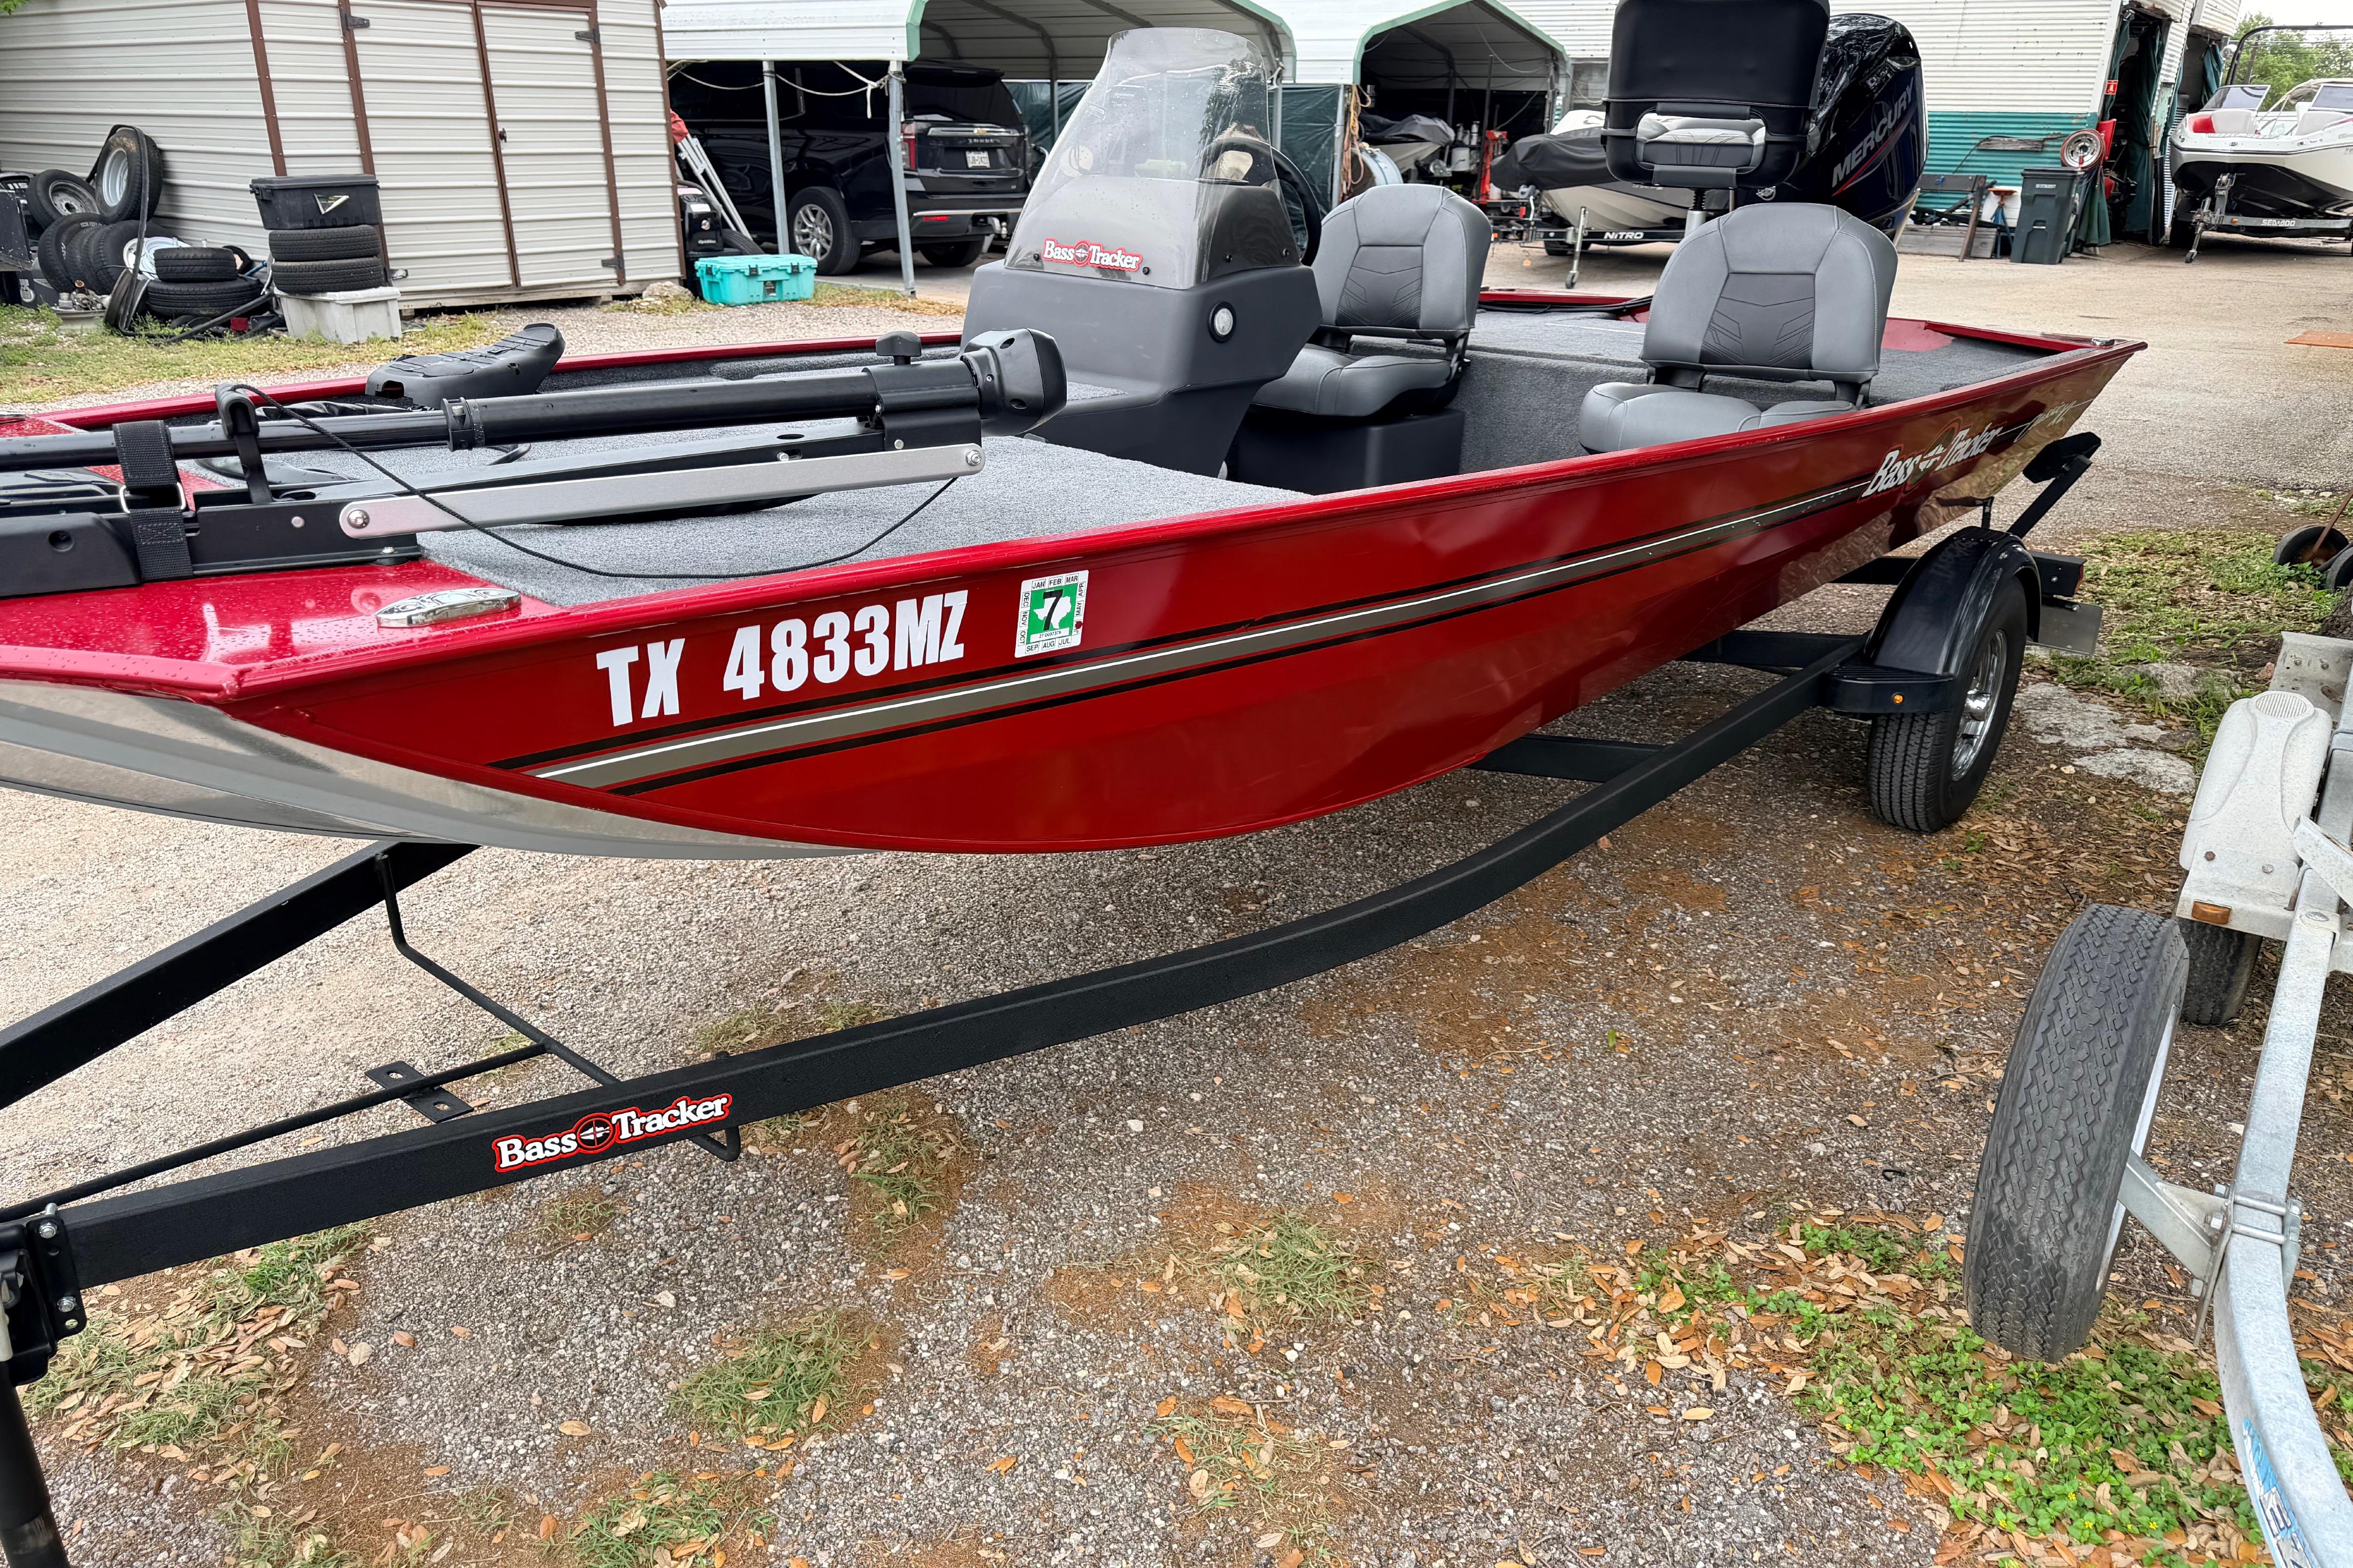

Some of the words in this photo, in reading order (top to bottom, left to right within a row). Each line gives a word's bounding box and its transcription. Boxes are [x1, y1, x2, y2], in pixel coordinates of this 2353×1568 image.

[1832, 76, 1914, 188] MERCURY
[1043, 240, 1075, 261] Bass
[1089, 245, 1140, 269] Tracker
[1861, 449, 1922, 497] Bass
[1935, 422, 2003, 471] Tracker
[1032, 581, 1045, 589] JAN
[1043, 588, 1063, 631] 7
[597, 638, 686, 727] TX
[723, 589, 968, 700] 4833MZ
[497, 1132, 578, 1168] Bass
[611, 1096, 728, 1140] Tracker
